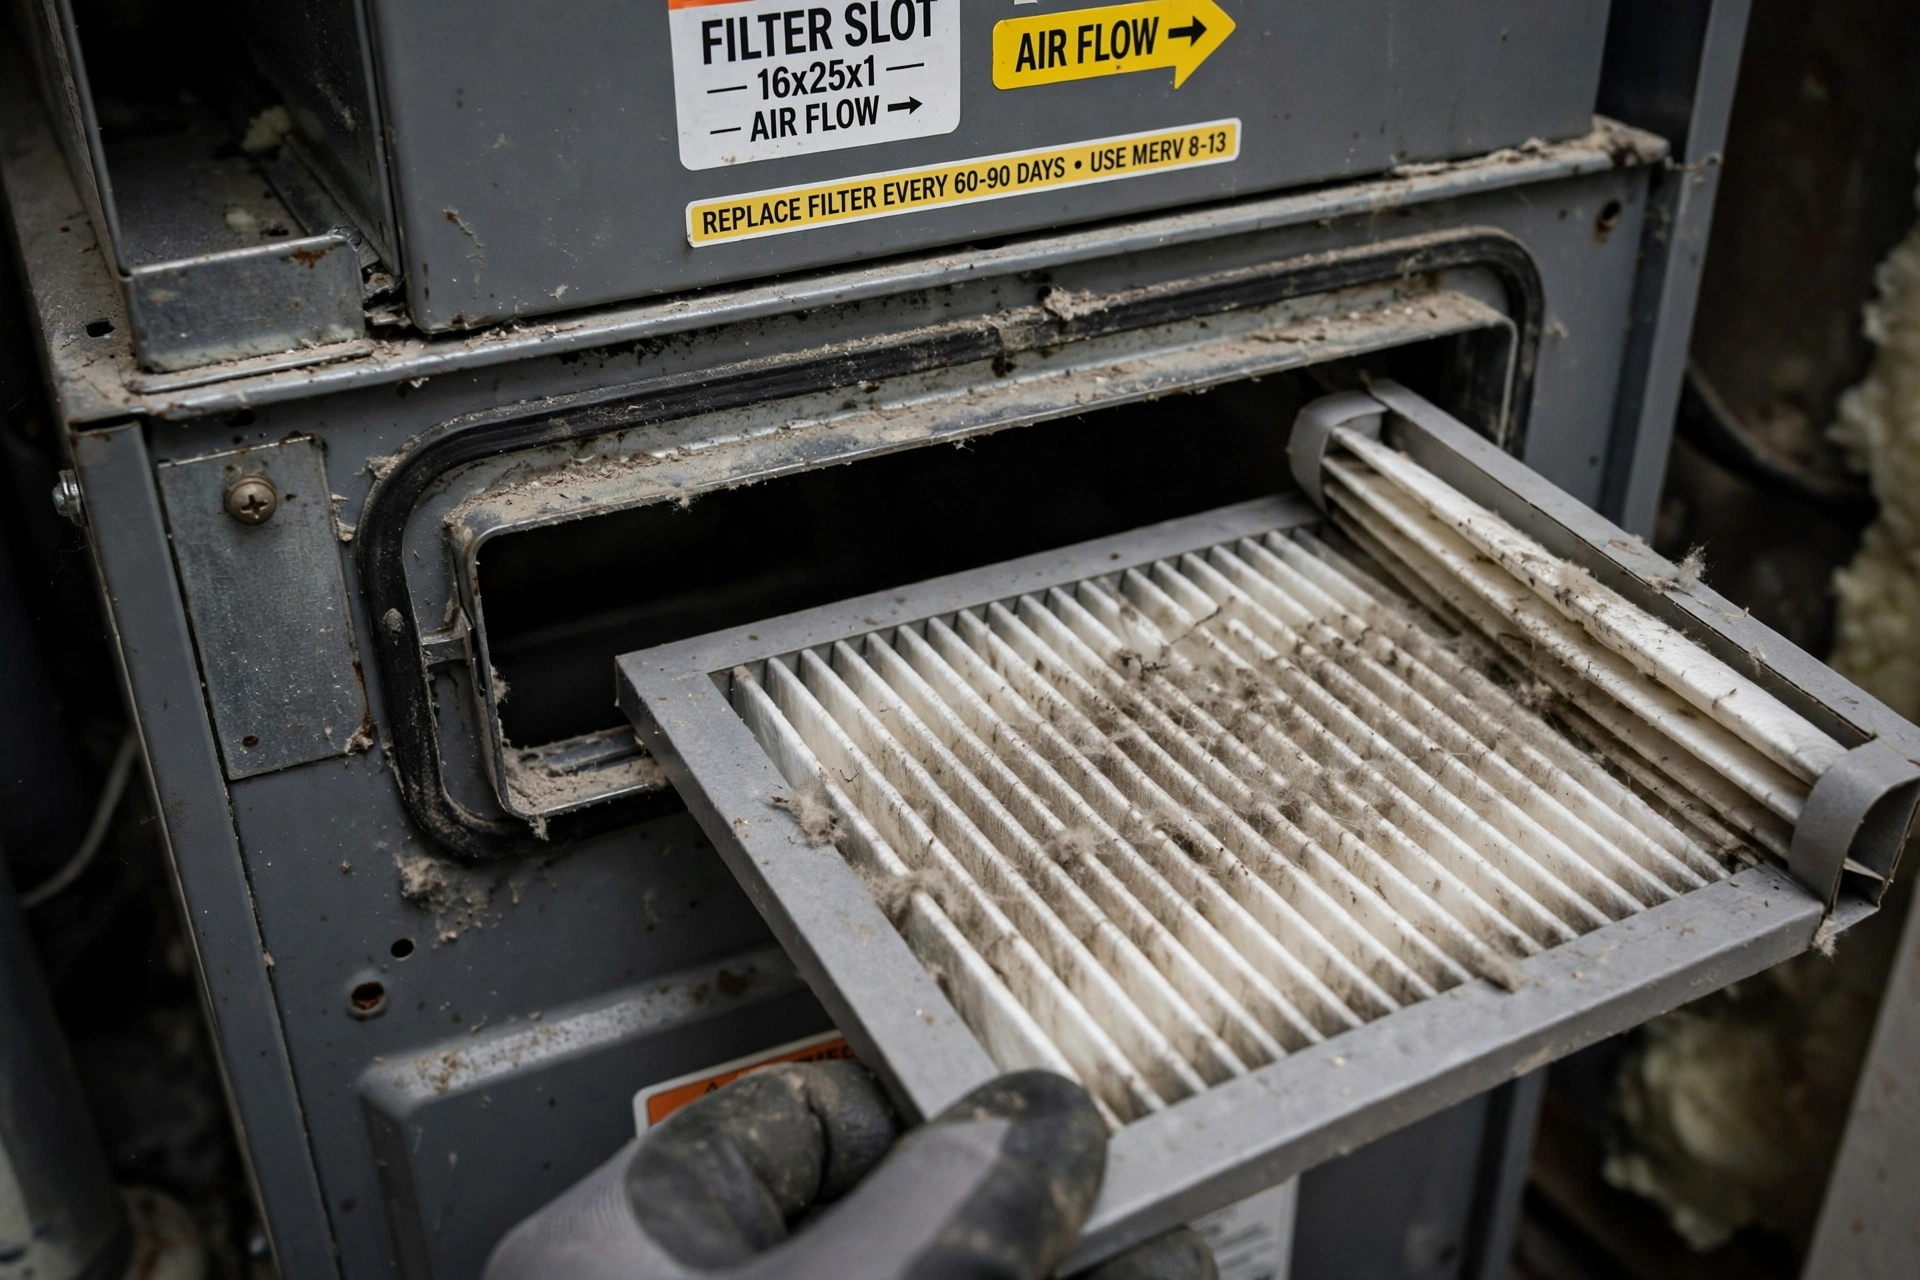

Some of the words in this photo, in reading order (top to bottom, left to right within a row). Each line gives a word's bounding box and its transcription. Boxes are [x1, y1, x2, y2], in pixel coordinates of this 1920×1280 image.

[701, 7, 834, 65] FILTER
[844, 0, 938, 48] SLOT
[1015, 28, 1068, 73] AIR
[1077, 16, 1160, 64] FLOW
[757, 54, 876, 101] 16x25x1
[750, 106, 798, 142] AIR
[805, 94, 880, 135] FLOW
[702, 199, 802, 235] REPLACE
[808, 187, 877, 218] FILTER
[883, 174, 948, 206] EVERY
[954, 165, 1011, 194] 60-90
[1017, 156, 1066, 185] DAYS
[1090, 146, 1127, 173] USE
[1132, 137, 1184, 166] MERV
[1188, 131, 1227, 157] 8-13
